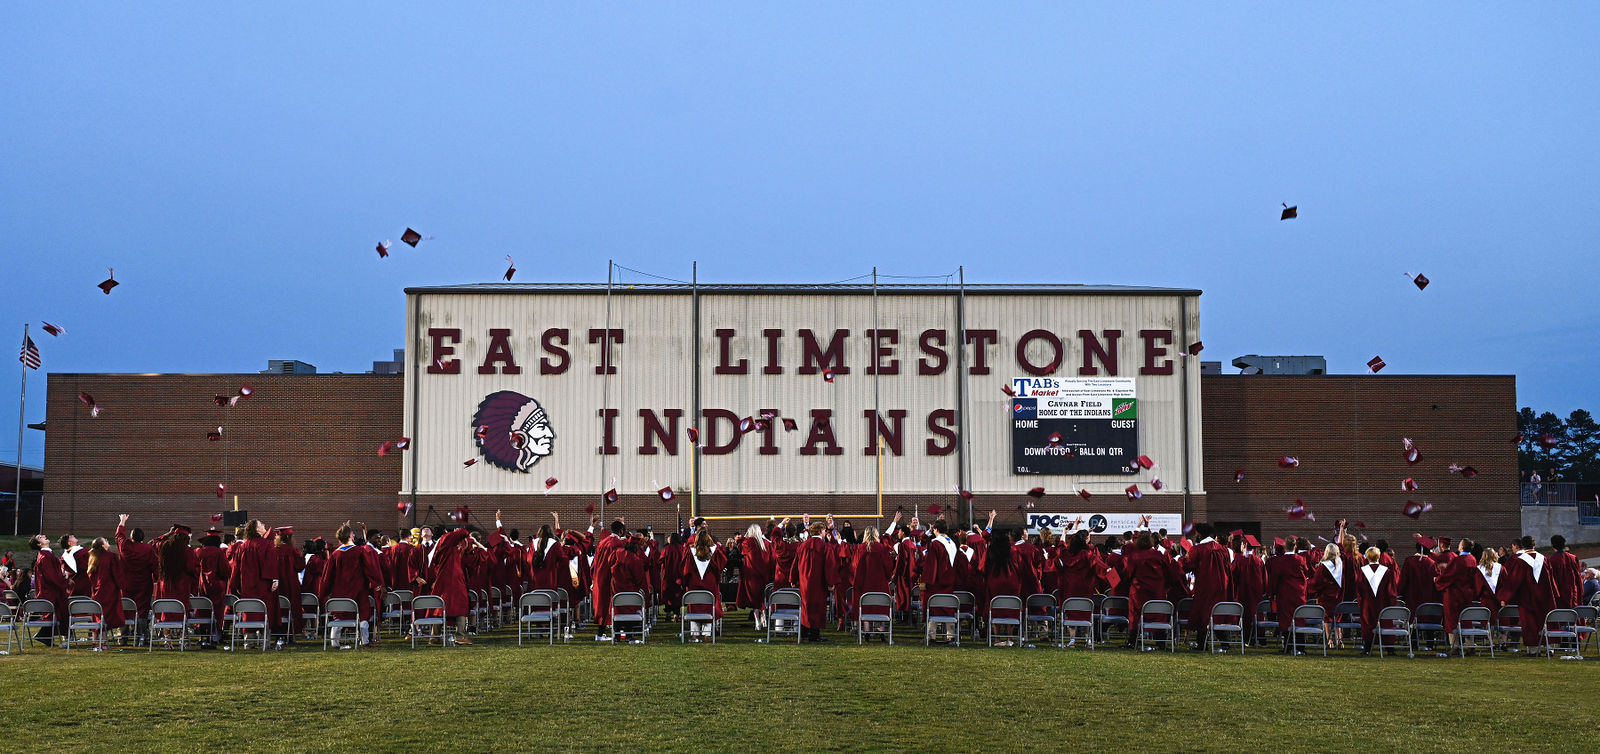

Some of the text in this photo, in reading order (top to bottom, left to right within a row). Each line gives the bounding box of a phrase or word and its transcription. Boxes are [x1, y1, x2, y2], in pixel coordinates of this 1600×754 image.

[427, 328, 1174, 376] EAST LIMESTONE
[1015, 420, 1039, 429] HOME
[1111, 420, 1136, 429] GUEST
[599, 409, 958, 456] INDIANS
[1024, 447, 1071, 456] DOWN TO GO
[1080, 447, 1106, 456] BALL ON
[1109, 447, 1123, 456] QTR
[1030, 515, 1060, 528] TOC
